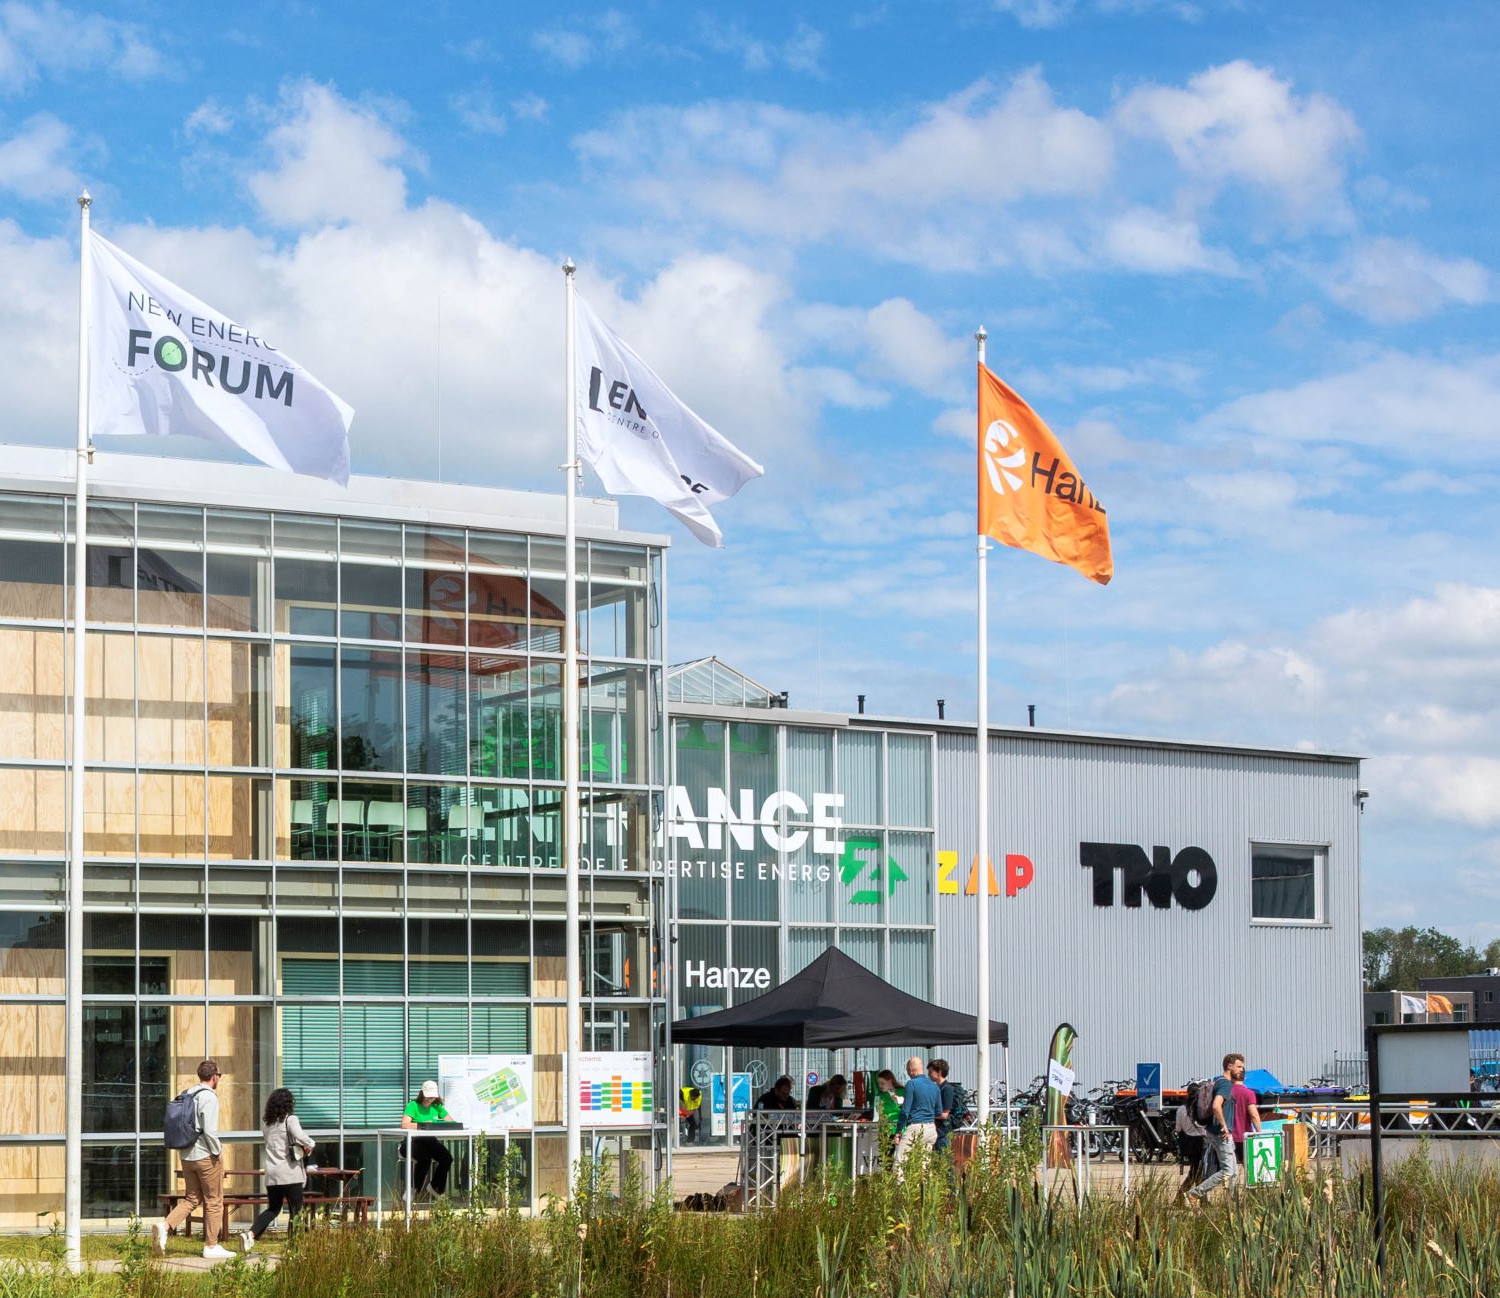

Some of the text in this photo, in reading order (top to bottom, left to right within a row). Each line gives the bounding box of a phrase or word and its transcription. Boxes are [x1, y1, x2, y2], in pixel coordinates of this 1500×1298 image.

[127, 290, 277, 351] NEW ENER
[127, 328, 295, 407] FORUM
[620, 858, 745, 880] EPERTISE
[757, 863, 846, 883] ENERGY
[1079, 841, 1218, 911] TNO
[685, 959, 771, 989] Hanze
